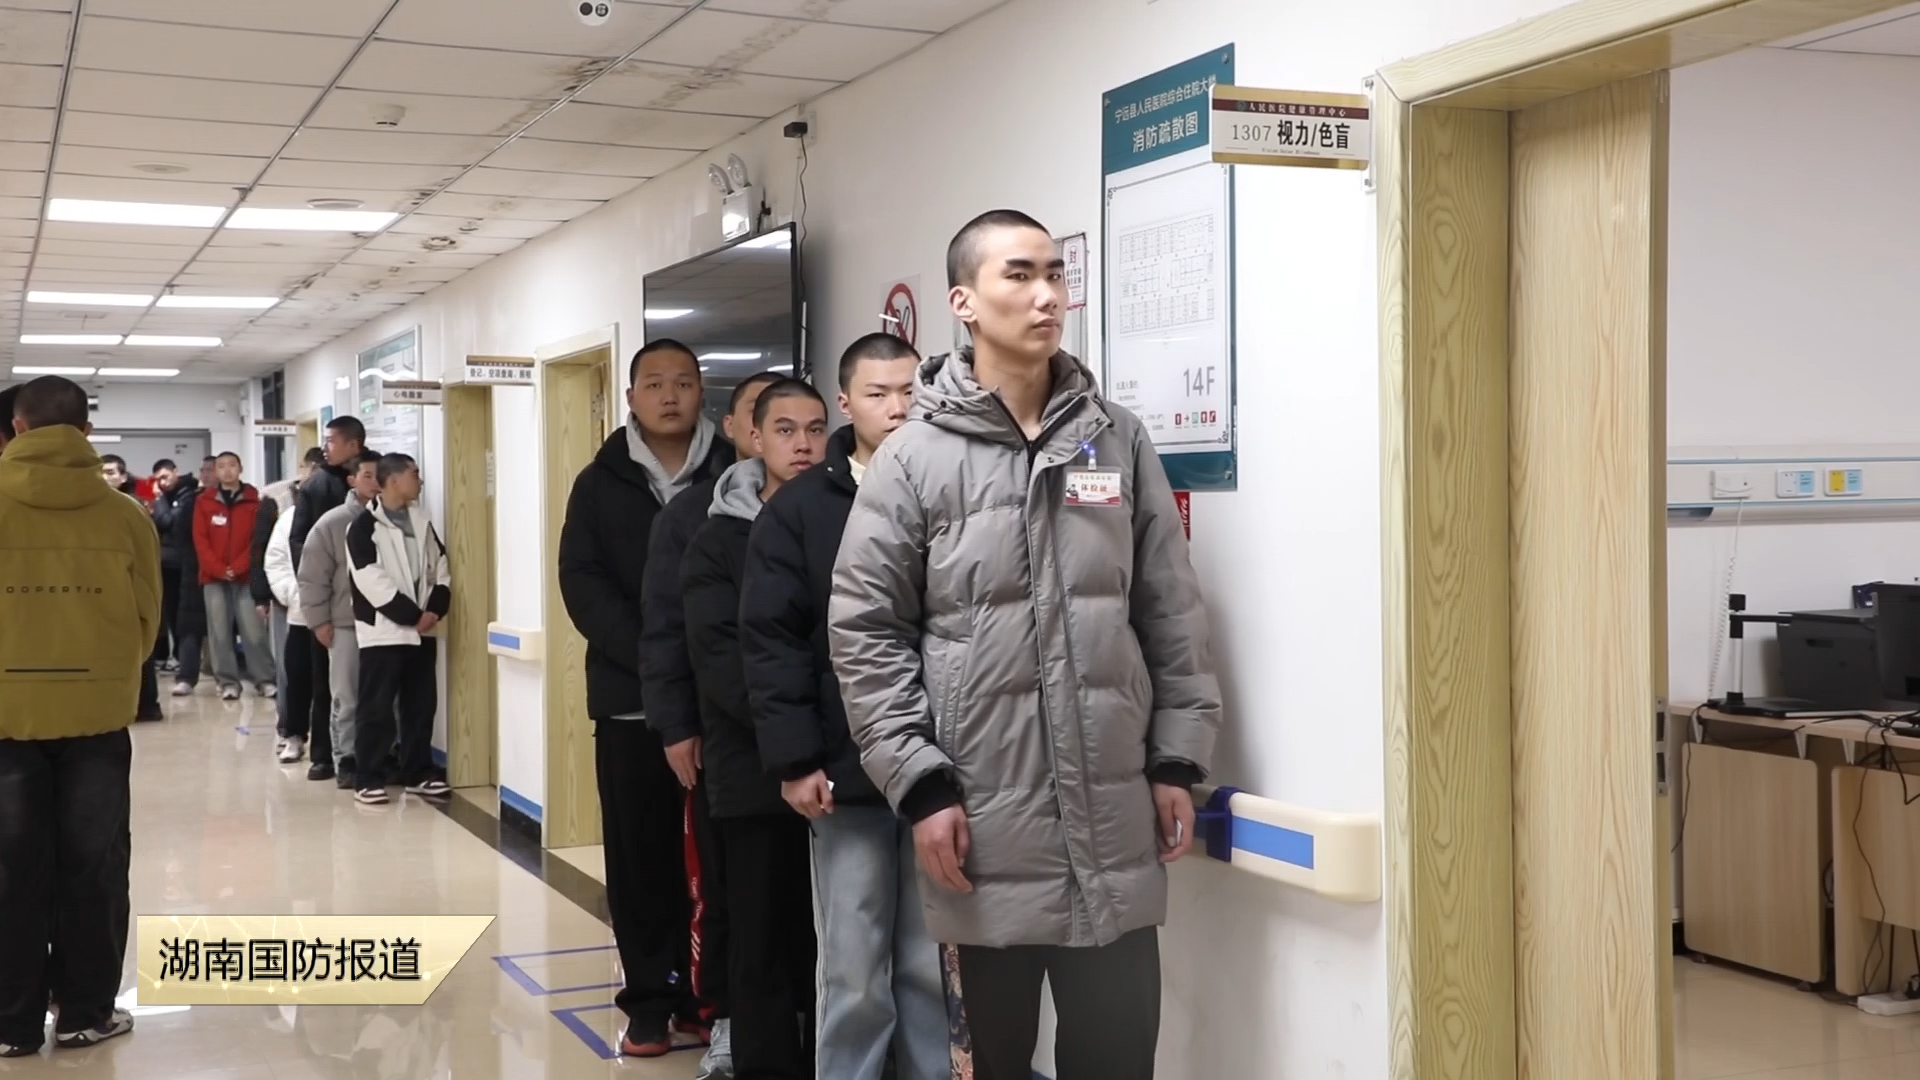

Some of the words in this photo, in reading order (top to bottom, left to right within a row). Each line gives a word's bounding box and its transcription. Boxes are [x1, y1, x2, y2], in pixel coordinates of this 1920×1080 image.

[1132, 111, 1199, 153] 消防疏散图
[1232, 124, 1272, 142] 1307
[1277, 119, 1351, 150] 视力/色盲
[1182, 366, 1216, 397] 14F
